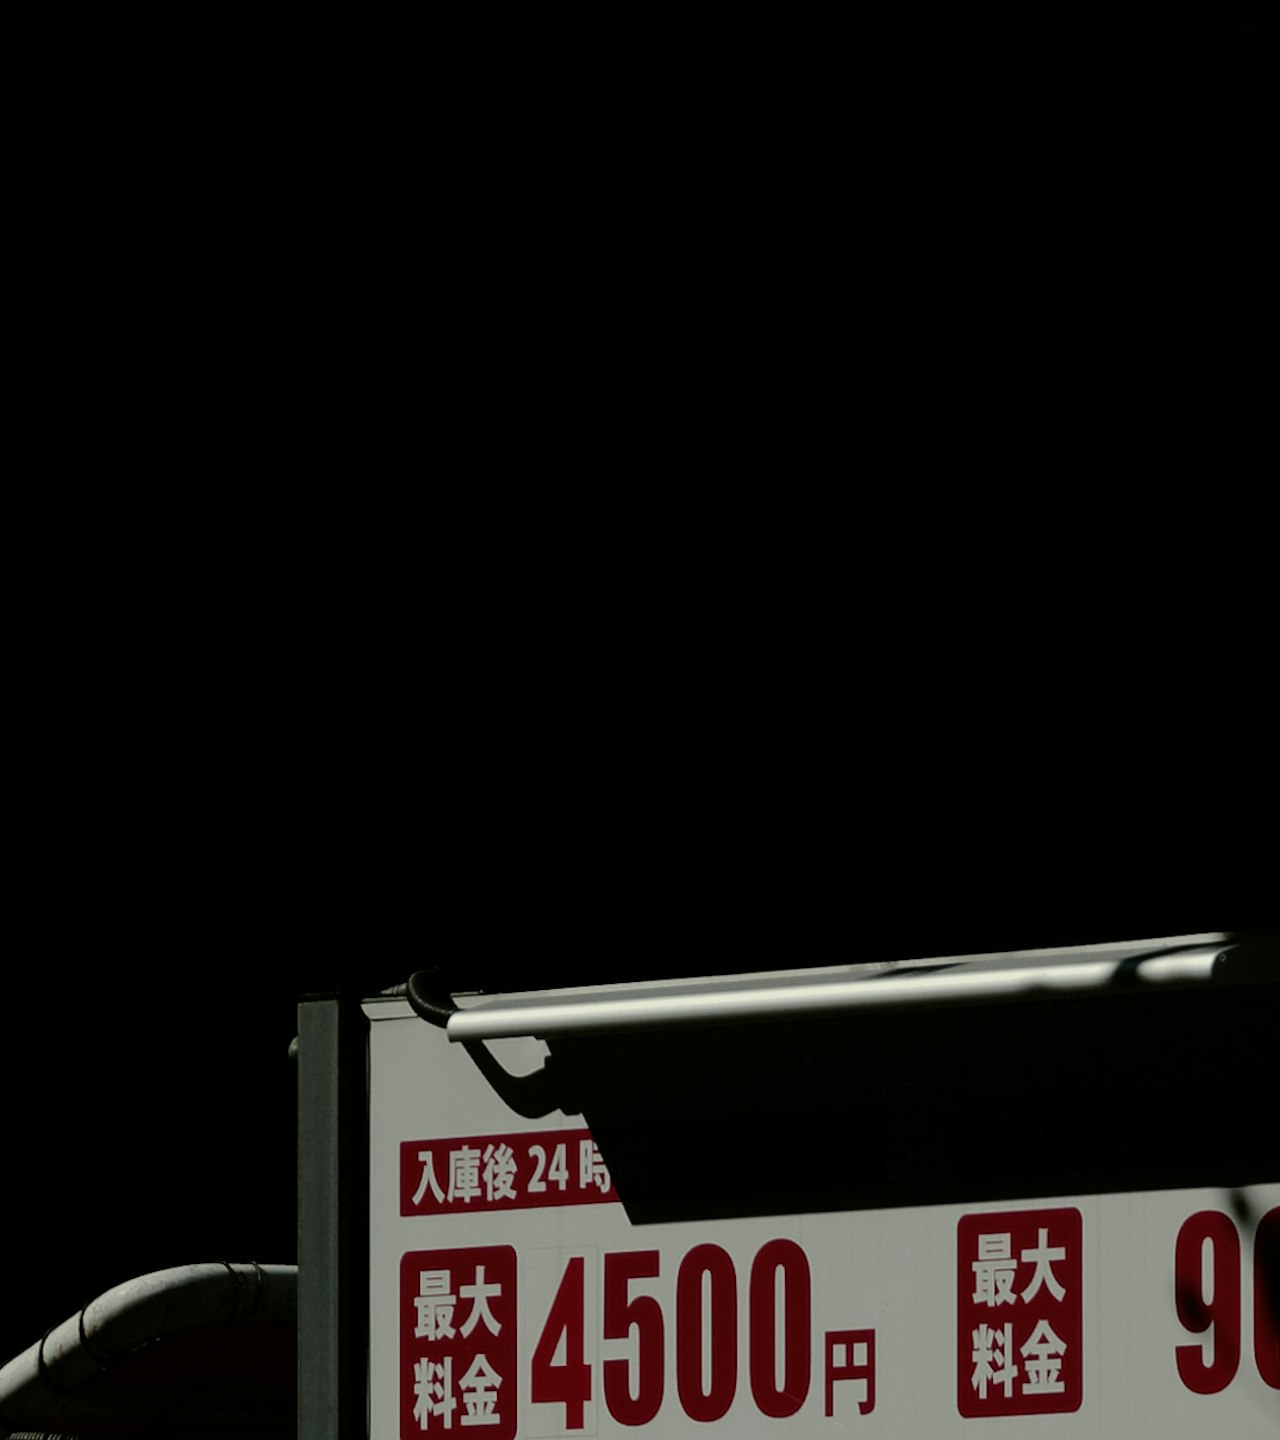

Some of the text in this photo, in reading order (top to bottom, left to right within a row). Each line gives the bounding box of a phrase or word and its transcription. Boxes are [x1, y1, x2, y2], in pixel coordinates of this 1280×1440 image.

[414, 1266, 503, 1342] 最大
[971, 1228, 1067, 1308] 最大
[413, 1352, 503, 1431] 料金
[971, 1318, 1067, 1400] 料金
